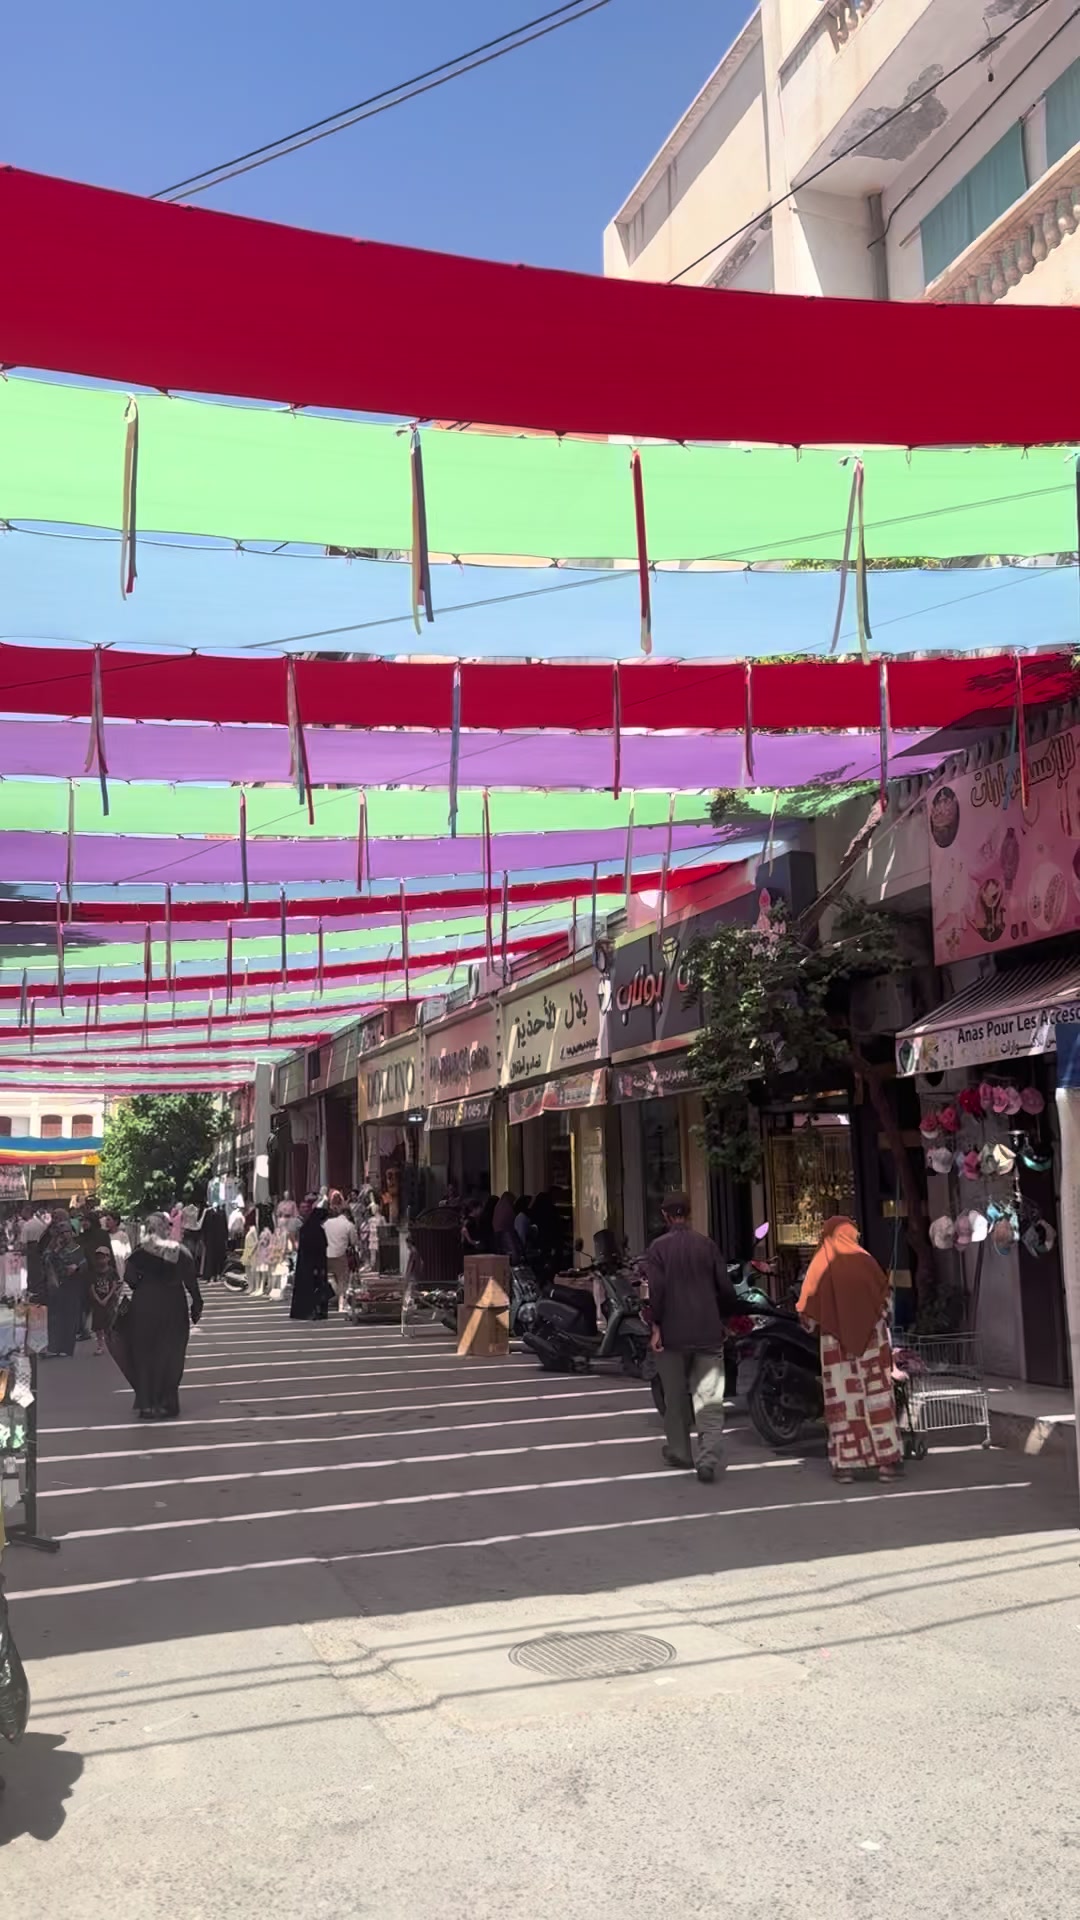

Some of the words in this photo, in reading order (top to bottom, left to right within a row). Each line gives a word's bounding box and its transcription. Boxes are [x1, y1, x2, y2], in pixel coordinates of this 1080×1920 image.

[957, 1028, 984, 1044] Anas
[987, 1019, 1014, 1037] Pour
[1017, 1014, 1037, 1031] Les
